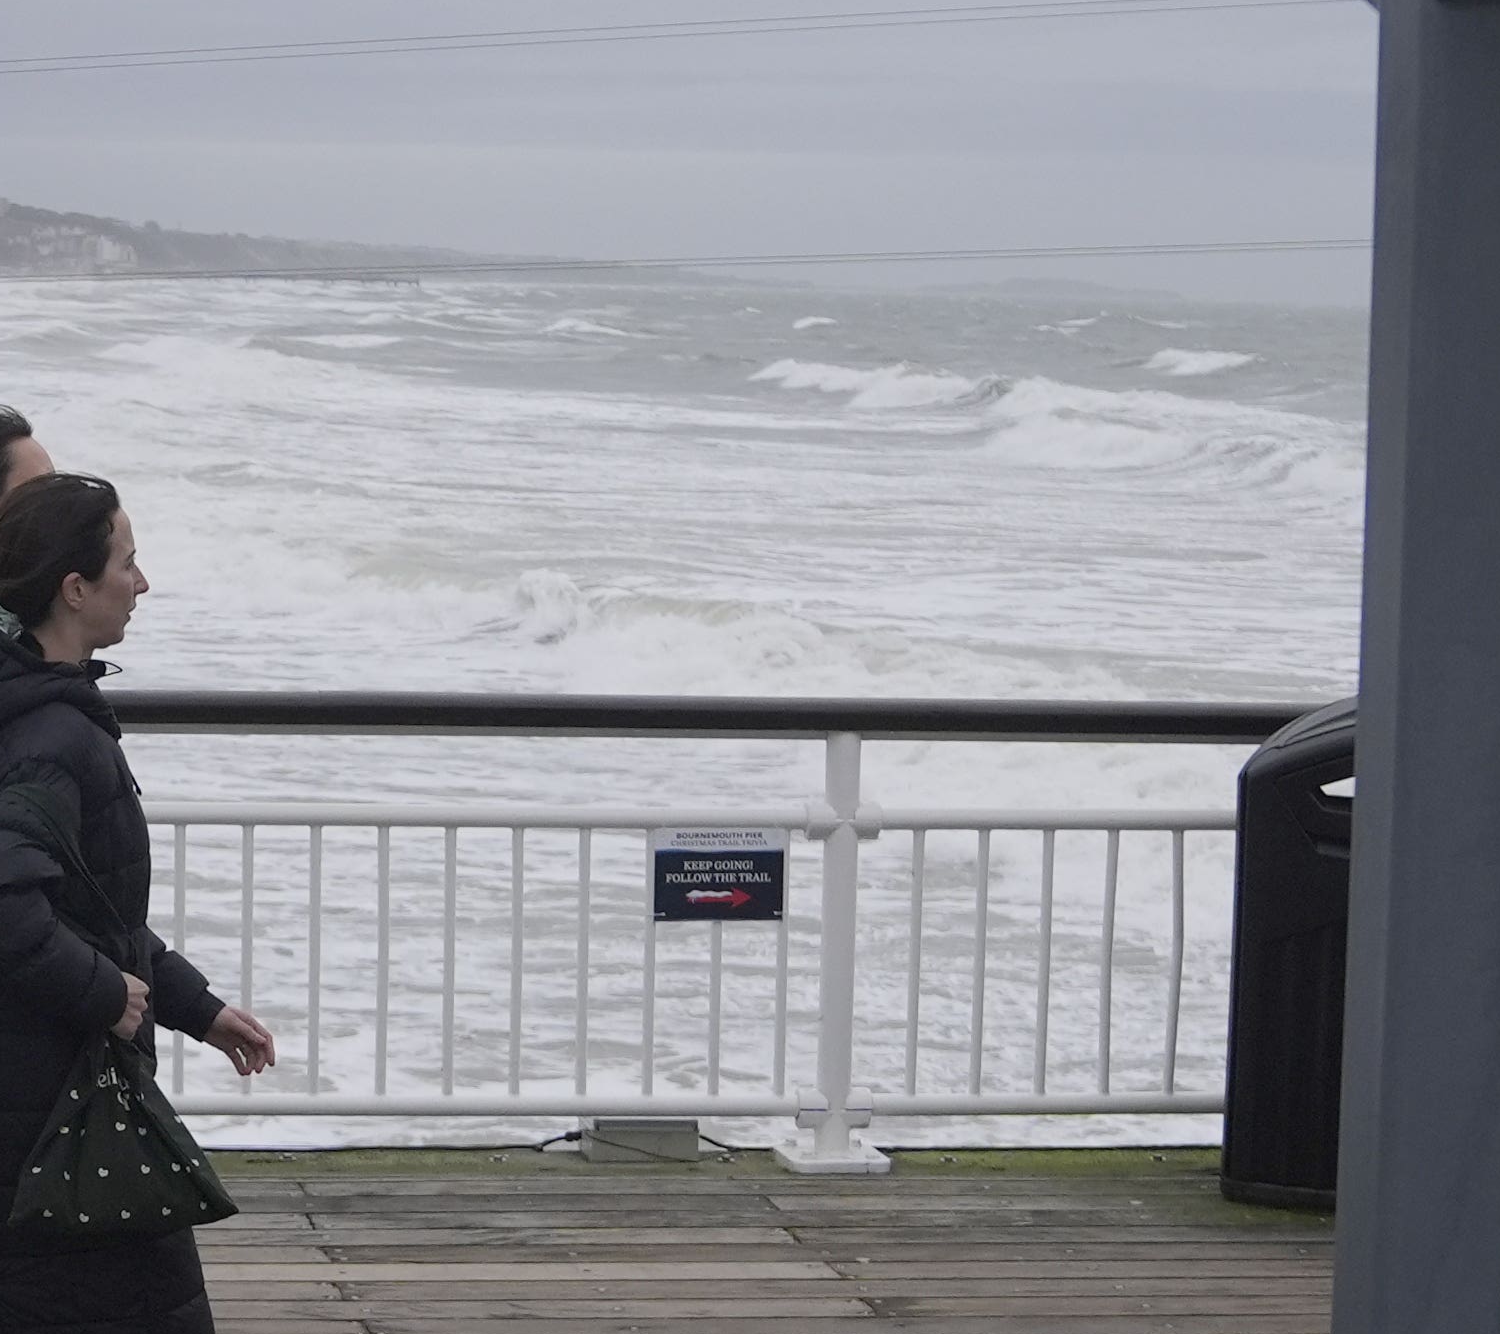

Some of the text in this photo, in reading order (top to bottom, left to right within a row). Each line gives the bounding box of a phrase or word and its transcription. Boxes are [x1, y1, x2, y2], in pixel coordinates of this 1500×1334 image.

[683, 860, 754, 870] KEEP GOING!
[665, 873, 772, 883] FOLLOW THE TRAIL
